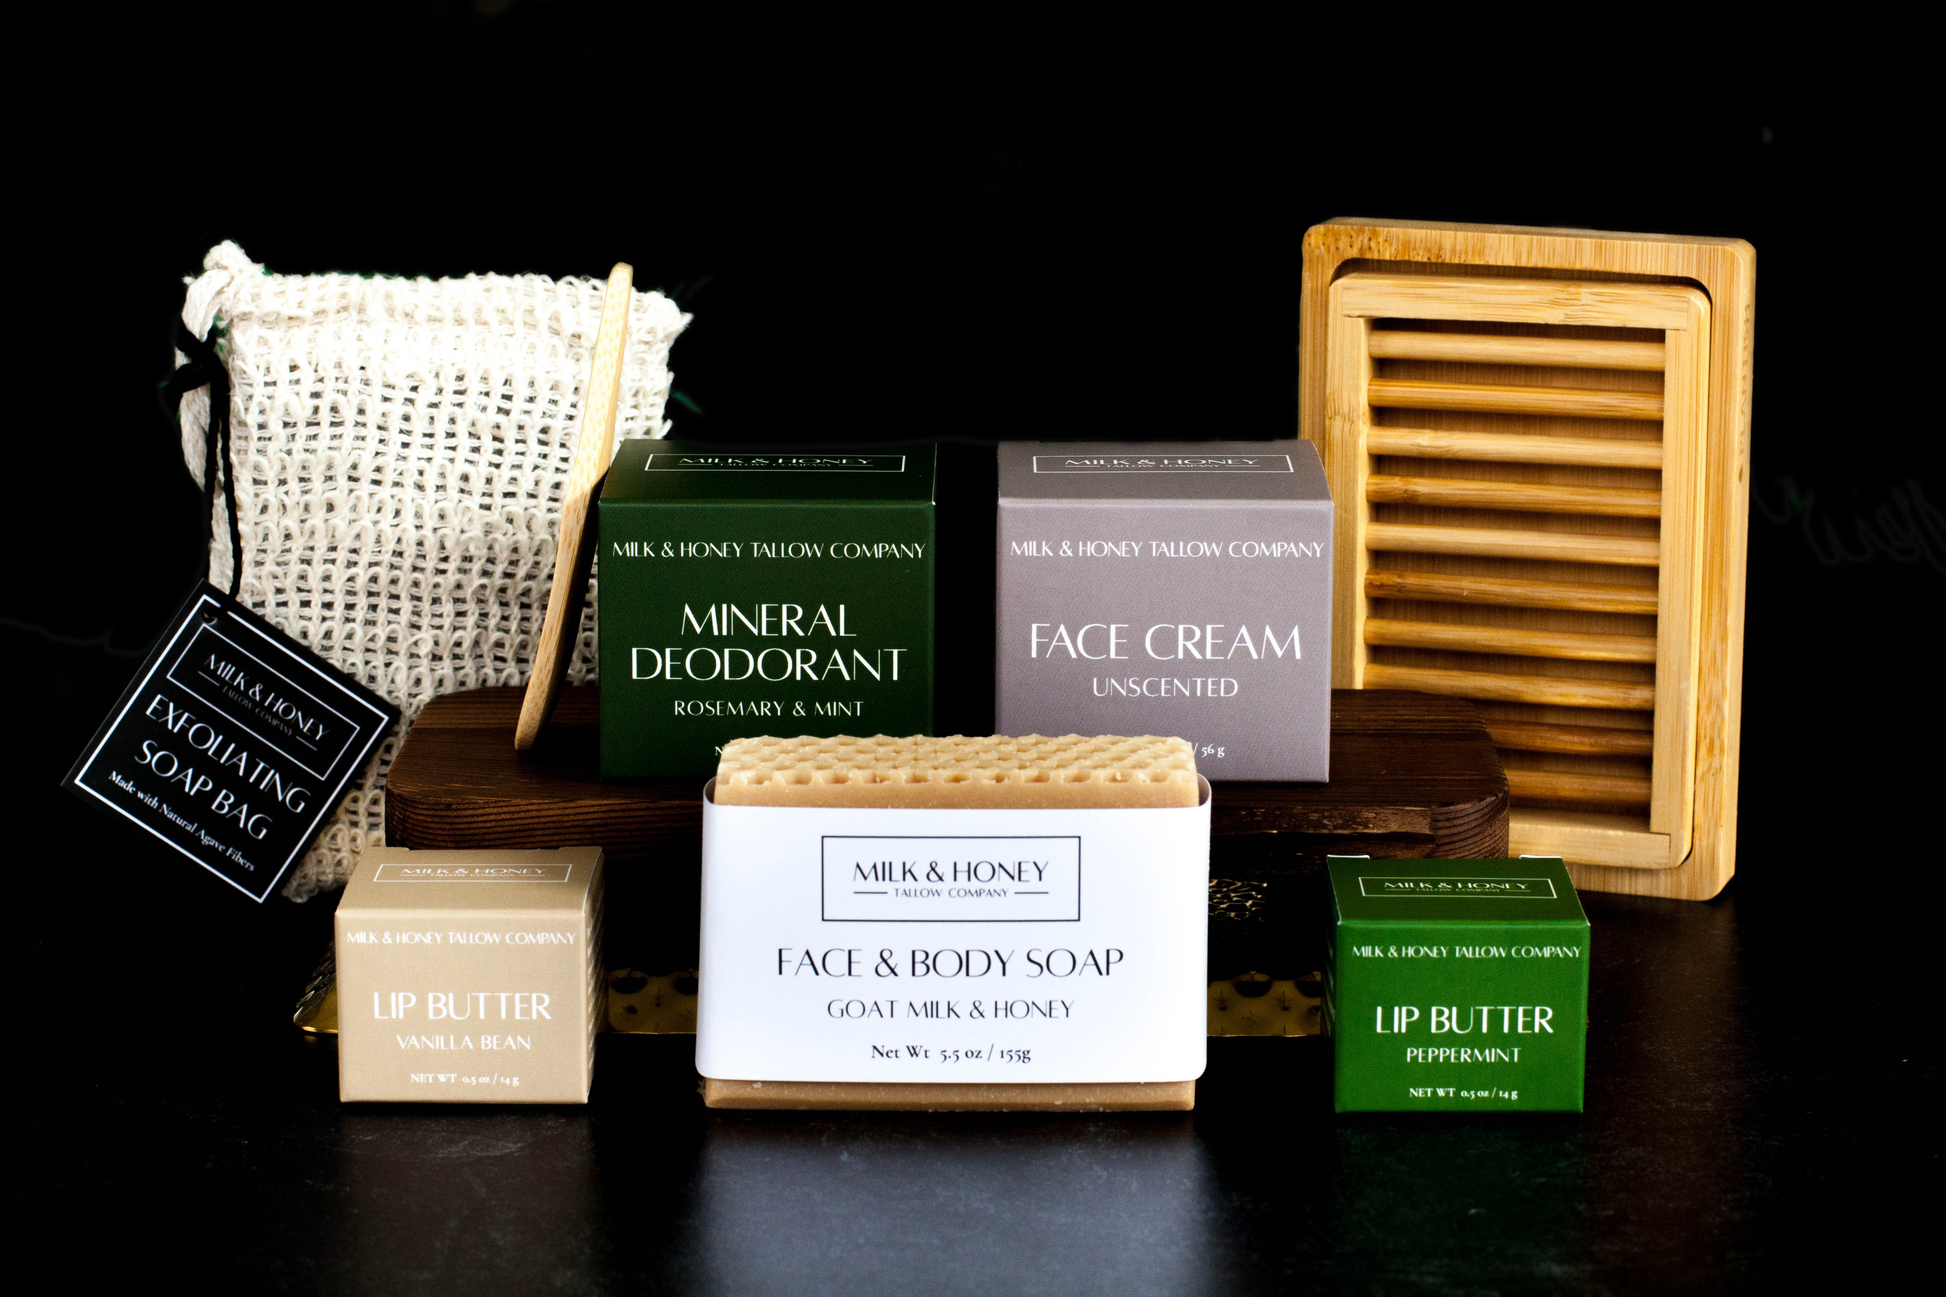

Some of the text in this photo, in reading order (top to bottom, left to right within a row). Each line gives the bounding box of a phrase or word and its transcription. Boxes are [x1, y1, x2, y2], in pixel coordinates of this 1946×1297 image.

[612, 541, 926, 559] MILK & HONEY TALLOW COMPANY
[1010, 540, 1325, 558] MILK & HONEY TALLOW COMPANY
[681, 603, 857, 637] MINERAL
[1030, 622, 1303, 661] FACE CREAM
[631, 647, 908, 681] DEODORANT
[204, 654, 330, 741] MILK & HONEY
[1092, 677, 1239, 697] UNSCENTED
[222, 686, 293, 736] TALLOW COMPANY
[674, 700, 864, 717] ROSEMARY & MINT
[145, 694, 311, 813] EXFOLIATING
[1201, 743, 1215, 758] 56
[1217, 745, 1225, 758] g
[134, 739, 273, 840] SOAP BAG
[108, 770, 256, 872] Made with Natural Agave Fibers
[853, 860, 1049, 884] MILK & HONEY
[894, 888, 1009, 899] TALLOW COMPANY
[347, 931, 577, 945] MILK & HONEY TALLOW COMPANY
[777, 947, 1125, 978] FACE & BODY SOAP
[1352, 946, 1582, 958] MILK & HONEY TALLOW COMPANY
[373, 992, 552, 1020] LIP BUTTER
[827, 999, 1075, 1020] GOAT MILK & HONEY
[1376, 1006, 1554, 1034] LIP BUTTER
[396, 1034, 531, 1050] VANILLA BEAN
[871, 1043, 1032, 1065] Net Wt 5.5 oz / 155g
[1406, 1047, 1522, 1063] PEPPERMINT
[410, 1073, 520, 1086] NET WT 0.5 oz / 14 g
[1409, 1087, 1518, 1100] NET WT 0.5 oz / 14 g
